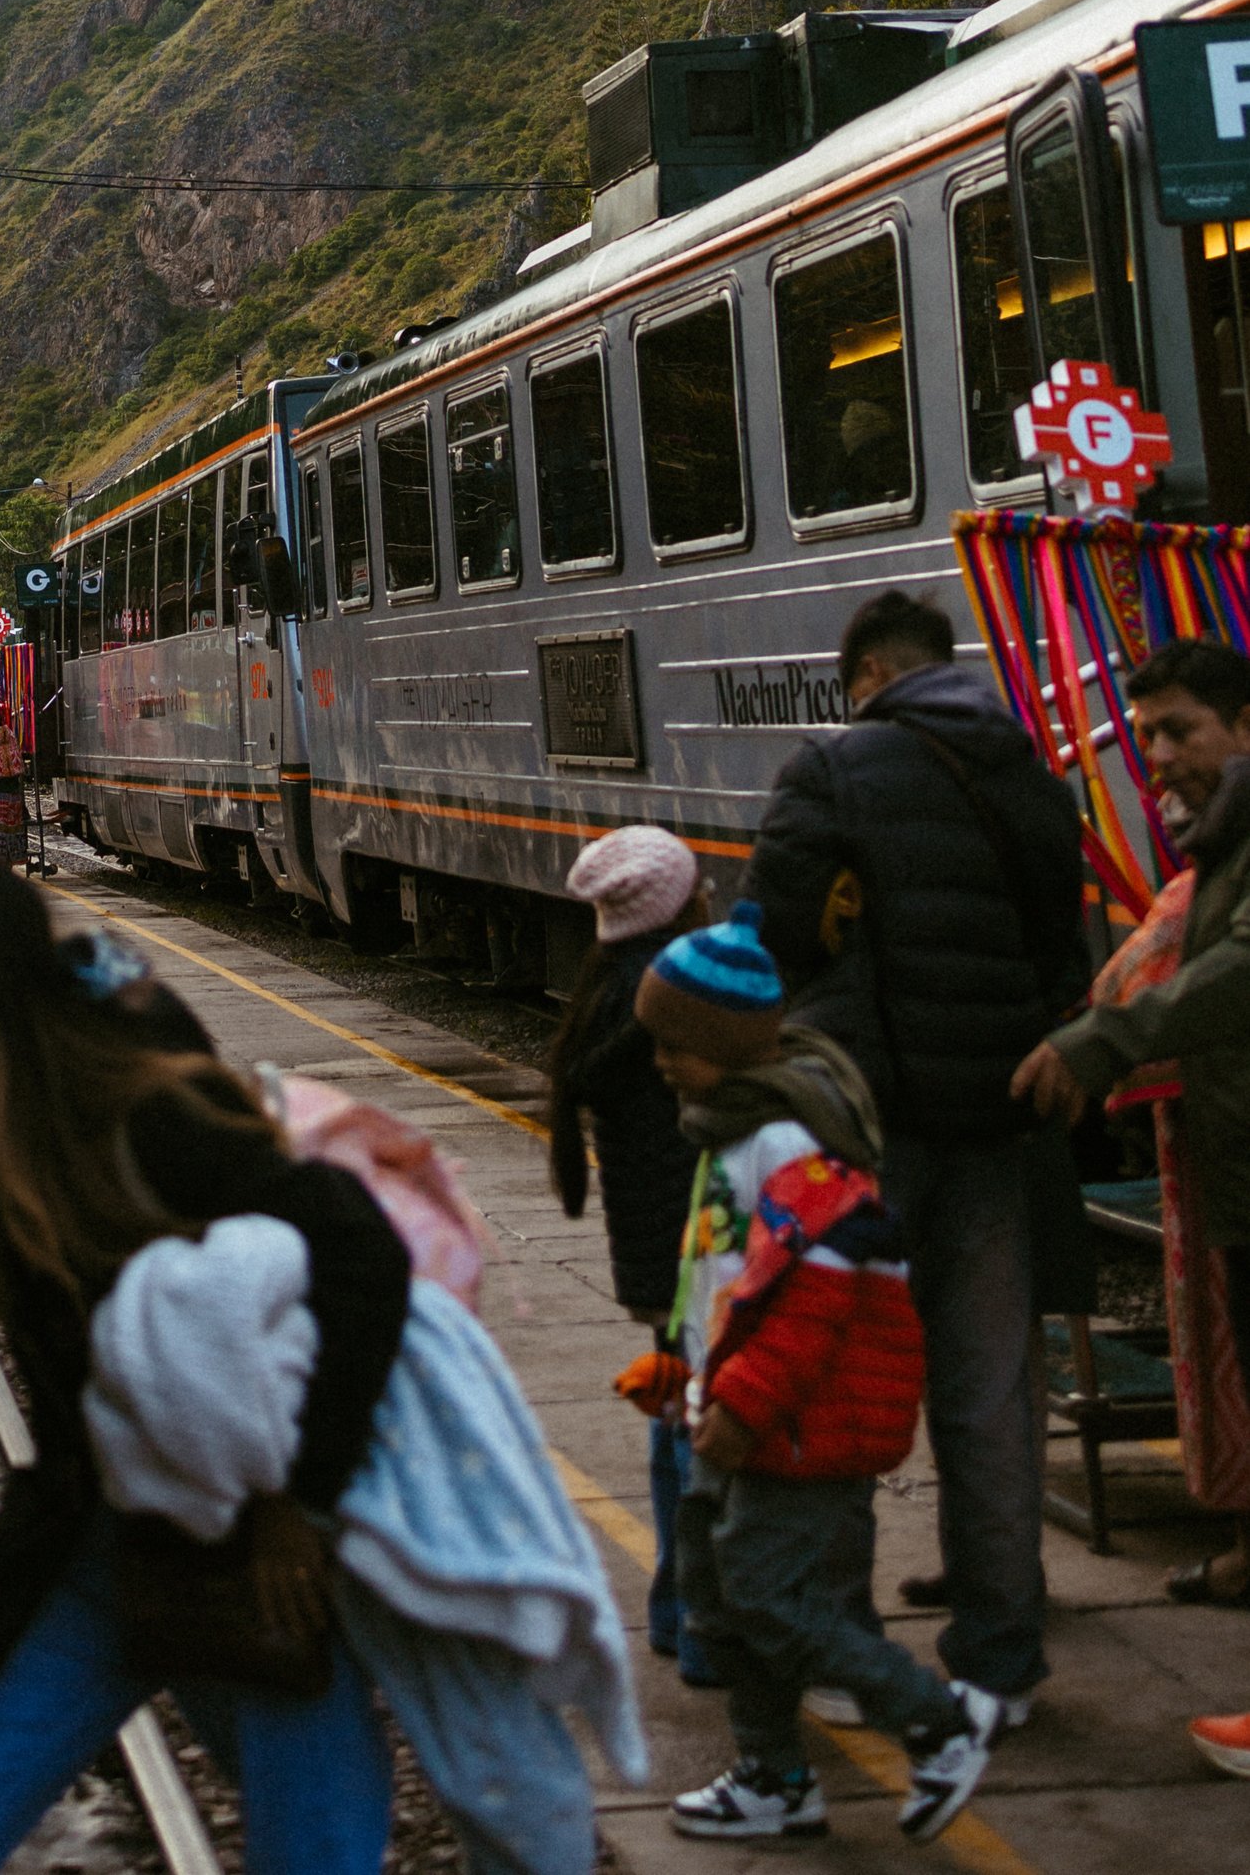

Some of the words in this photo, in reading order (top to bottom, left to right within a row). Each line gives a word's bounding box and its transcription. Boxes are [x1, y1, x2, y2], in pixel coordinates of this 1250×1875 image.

[1084, 413, 1111, 450] F
[26, 568, 50, 592] G
[561, 653, 623, 695] VOYAGER
[415, 673, 493, 732] VOYAGER
